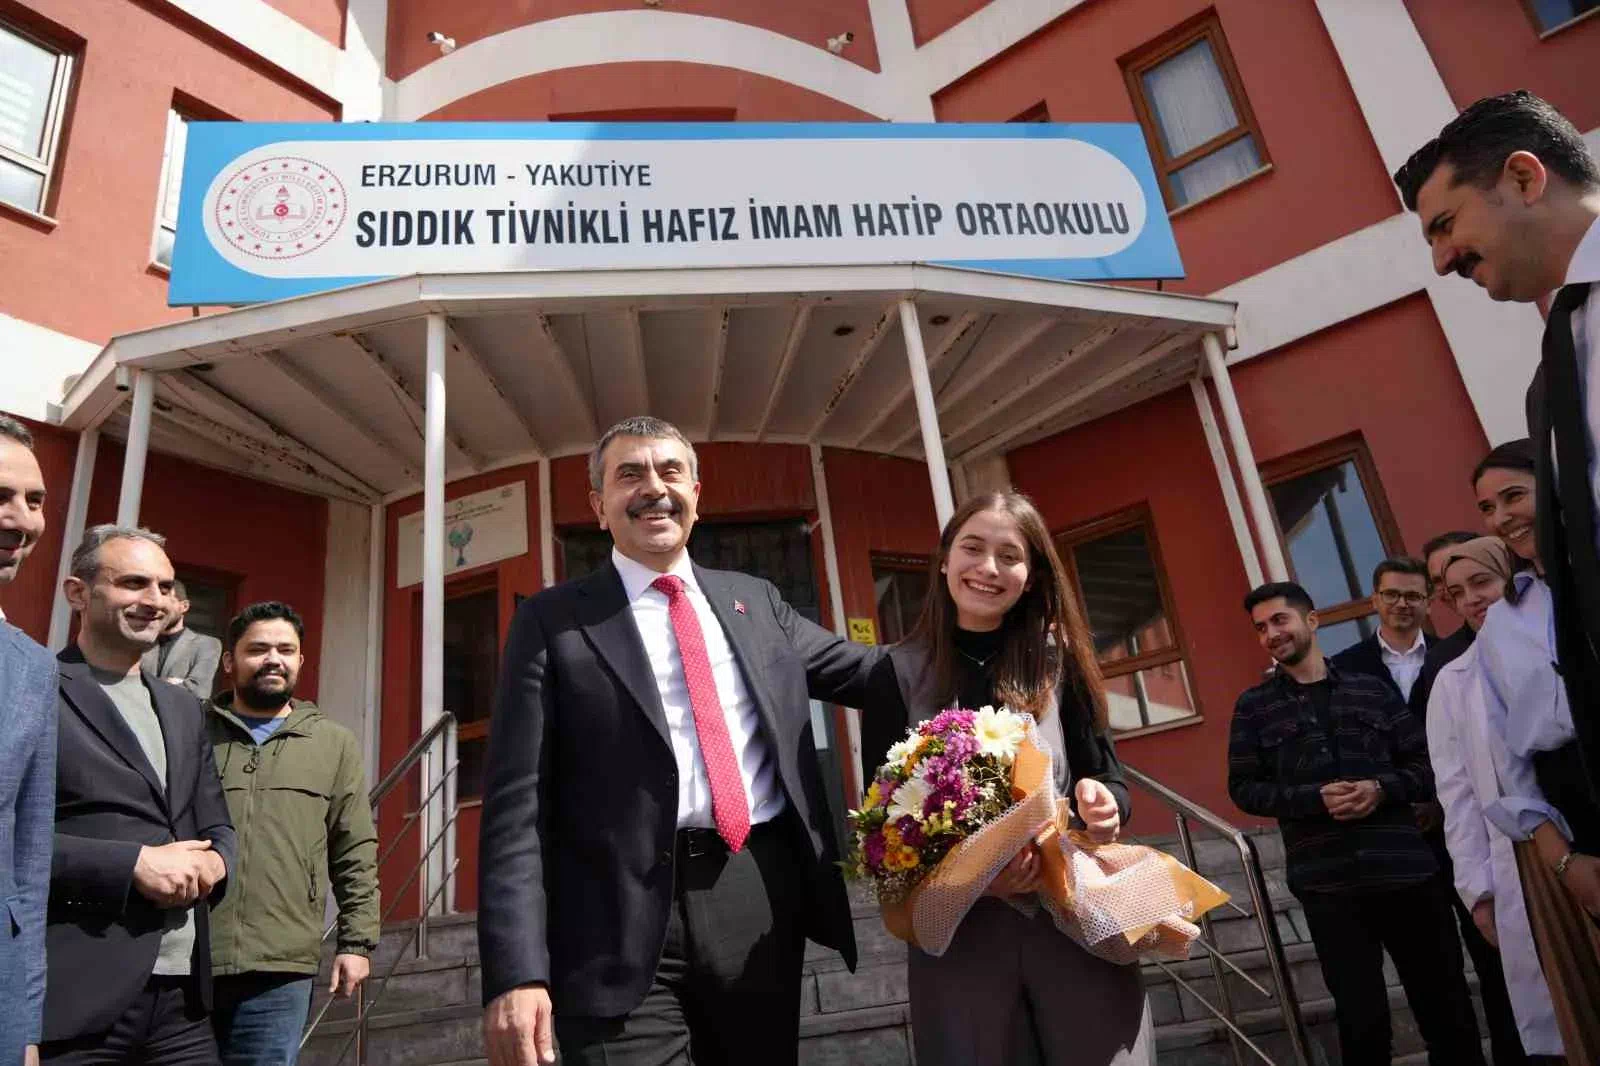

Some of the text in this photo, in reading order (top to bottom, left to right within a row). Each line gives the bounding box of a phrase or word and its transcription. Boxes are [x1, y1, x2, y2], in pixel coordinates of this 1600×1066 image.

[362, 165, 495, 186] ERZURUM
[526, 160, 651, 186] YAKUTİYE
[356, 195, 1129, 247] SIDDIK TİVNİKLİ HAFIZ İMAM HATİP ORTAOKULU
